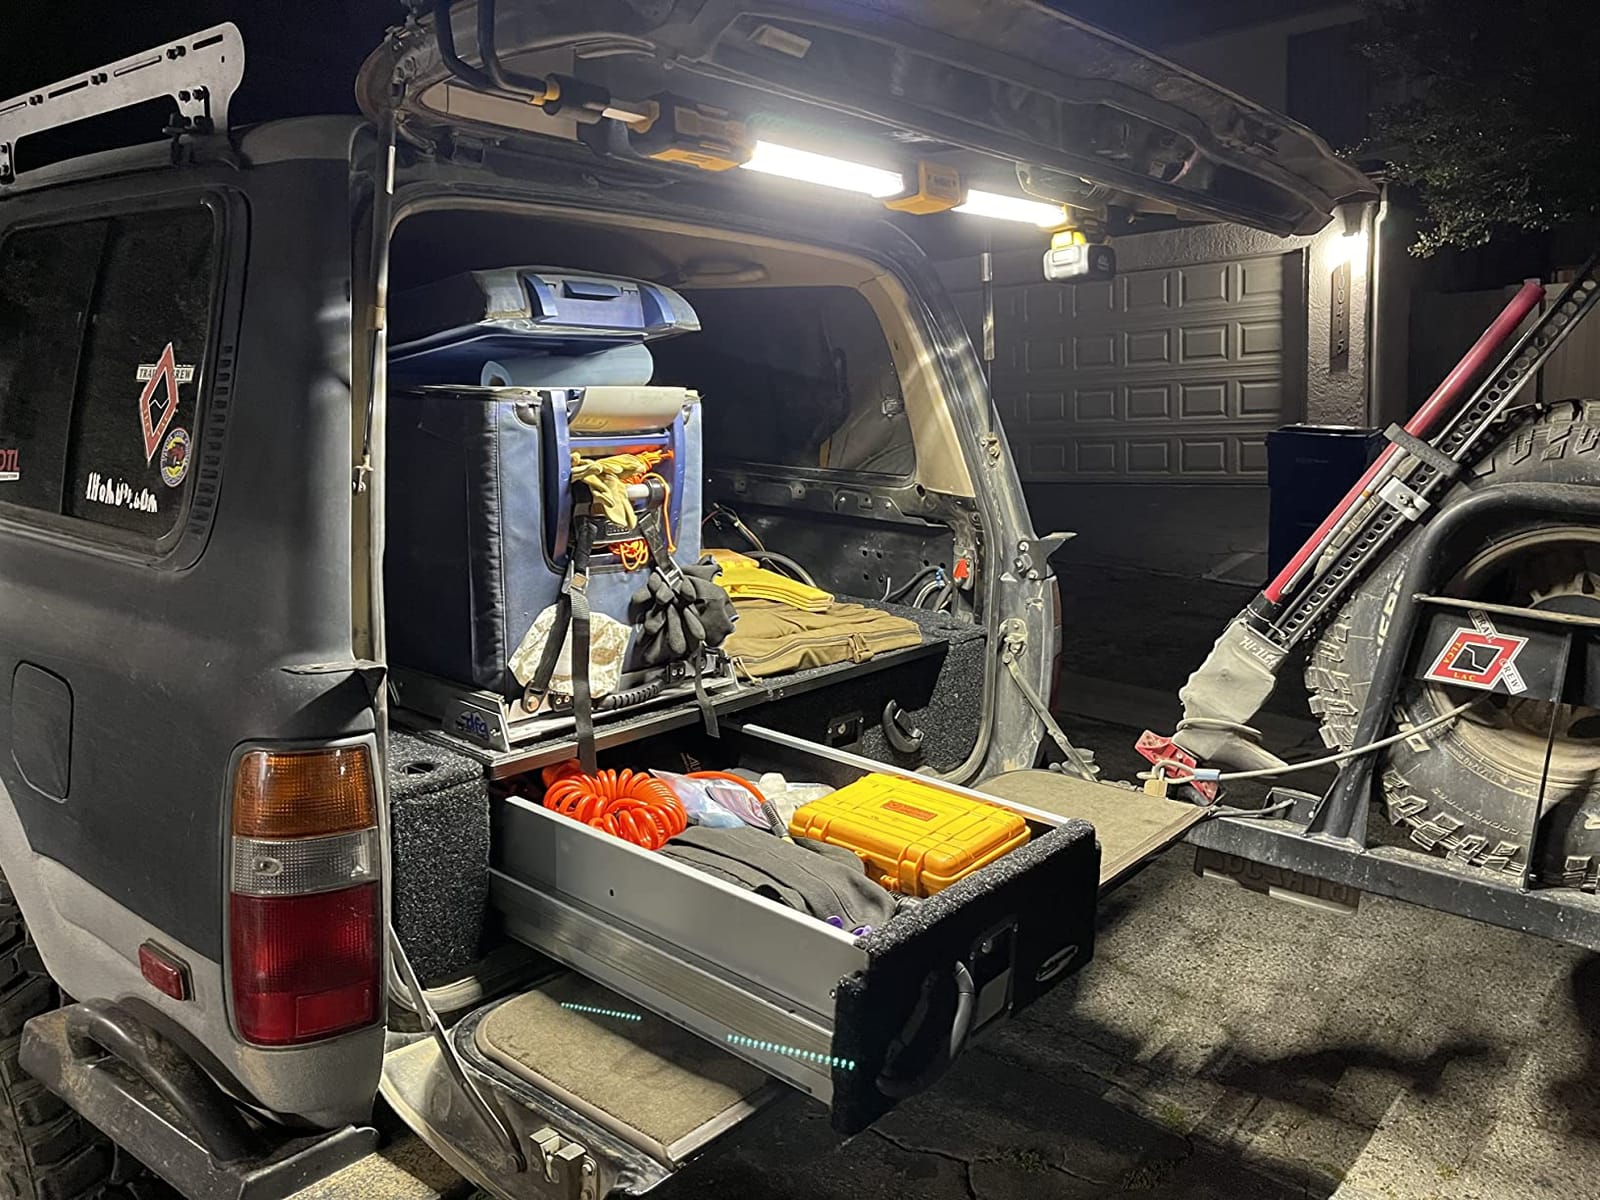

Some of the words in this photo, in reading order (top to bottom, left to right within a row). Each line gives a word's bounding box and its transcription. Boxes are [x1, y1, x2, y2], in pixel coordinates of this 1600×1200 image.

[1442, 640, 1463, 665] TLCA
[1473, 611, 1497, 643] TRAIL
[1498, 657, 1522, 689] CREW
[1452, 671, 1477, 682] LAC
